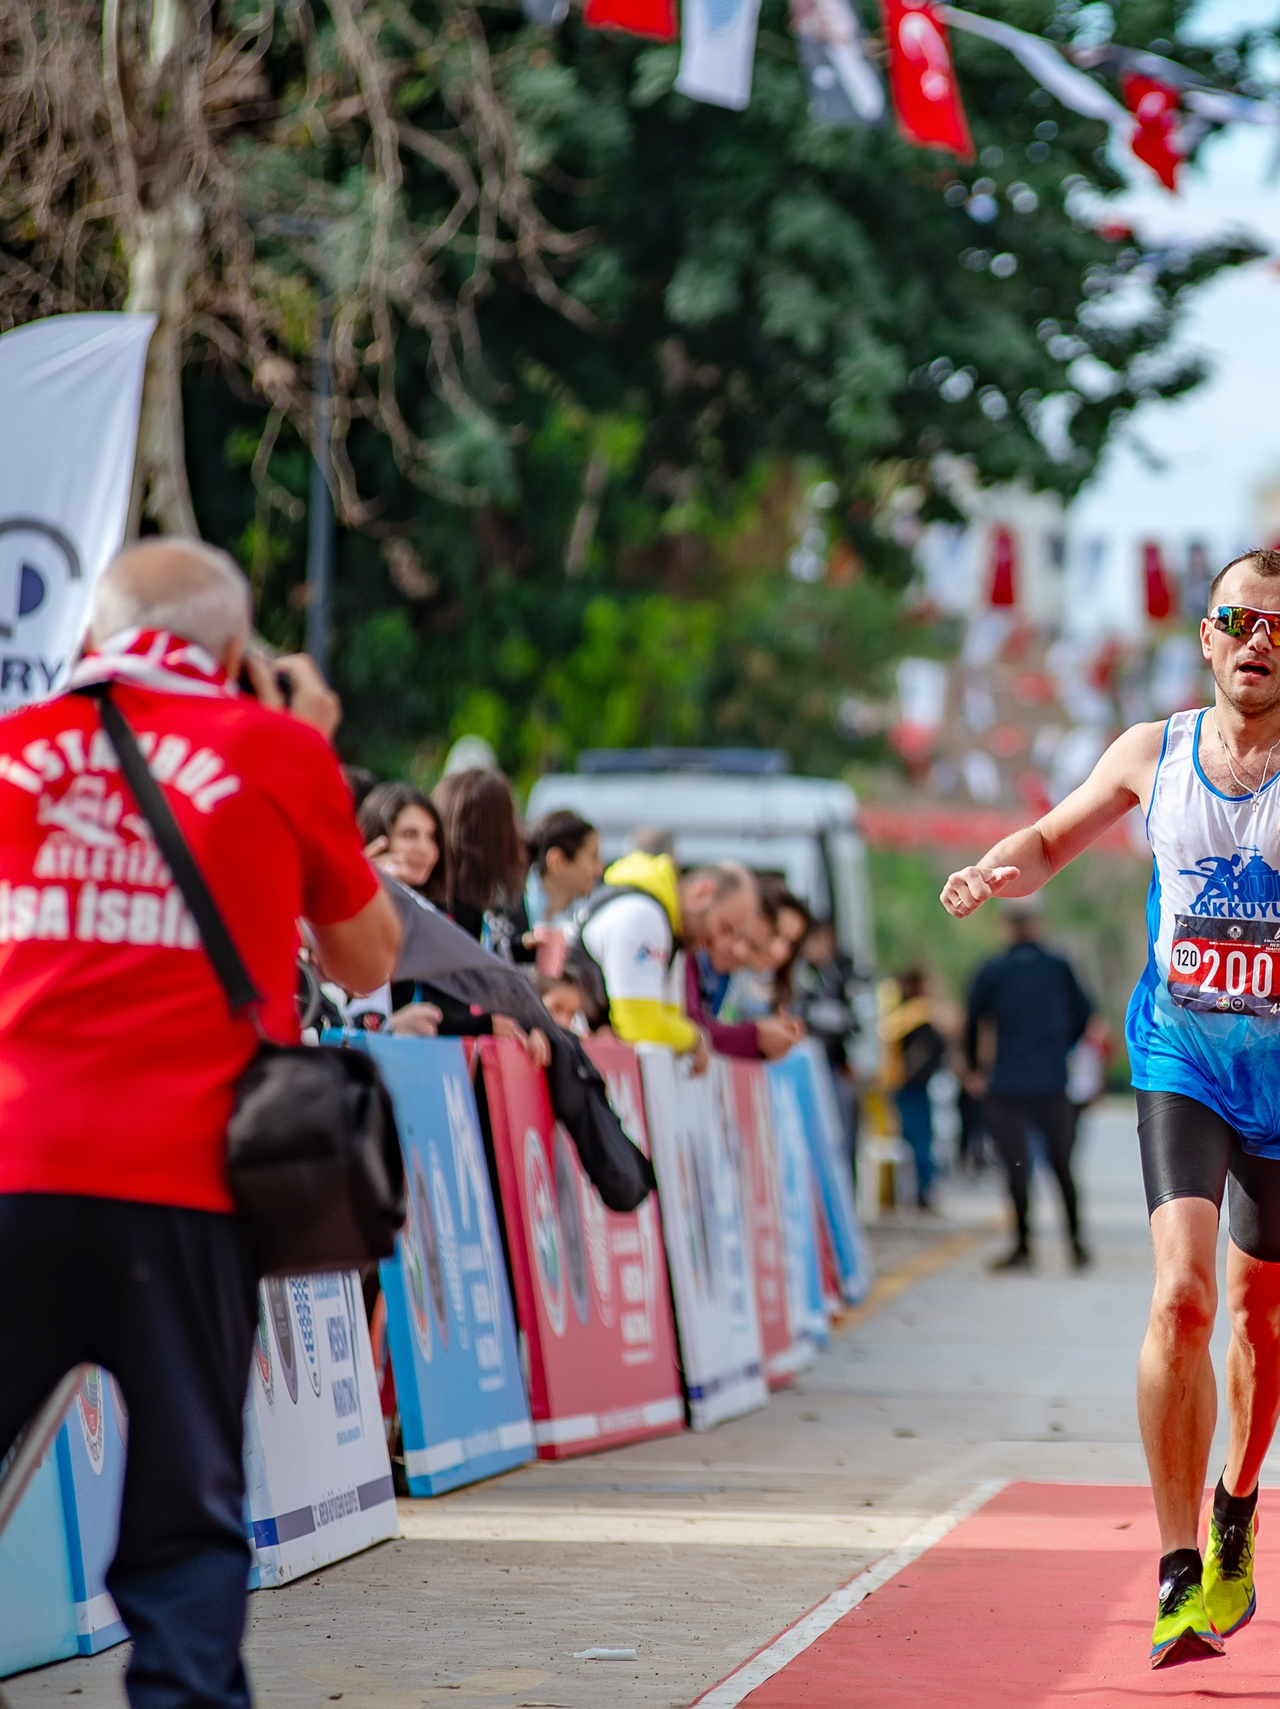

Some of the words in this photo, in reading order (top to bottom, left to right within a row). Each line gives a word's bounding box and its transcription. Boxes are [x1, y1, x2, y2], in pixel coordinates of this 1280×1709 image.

[33, 840, 173, 888] ATLETİZ
[1176, 949, 1197, 967] 120
[1199, 949, 1273, 998] 200
